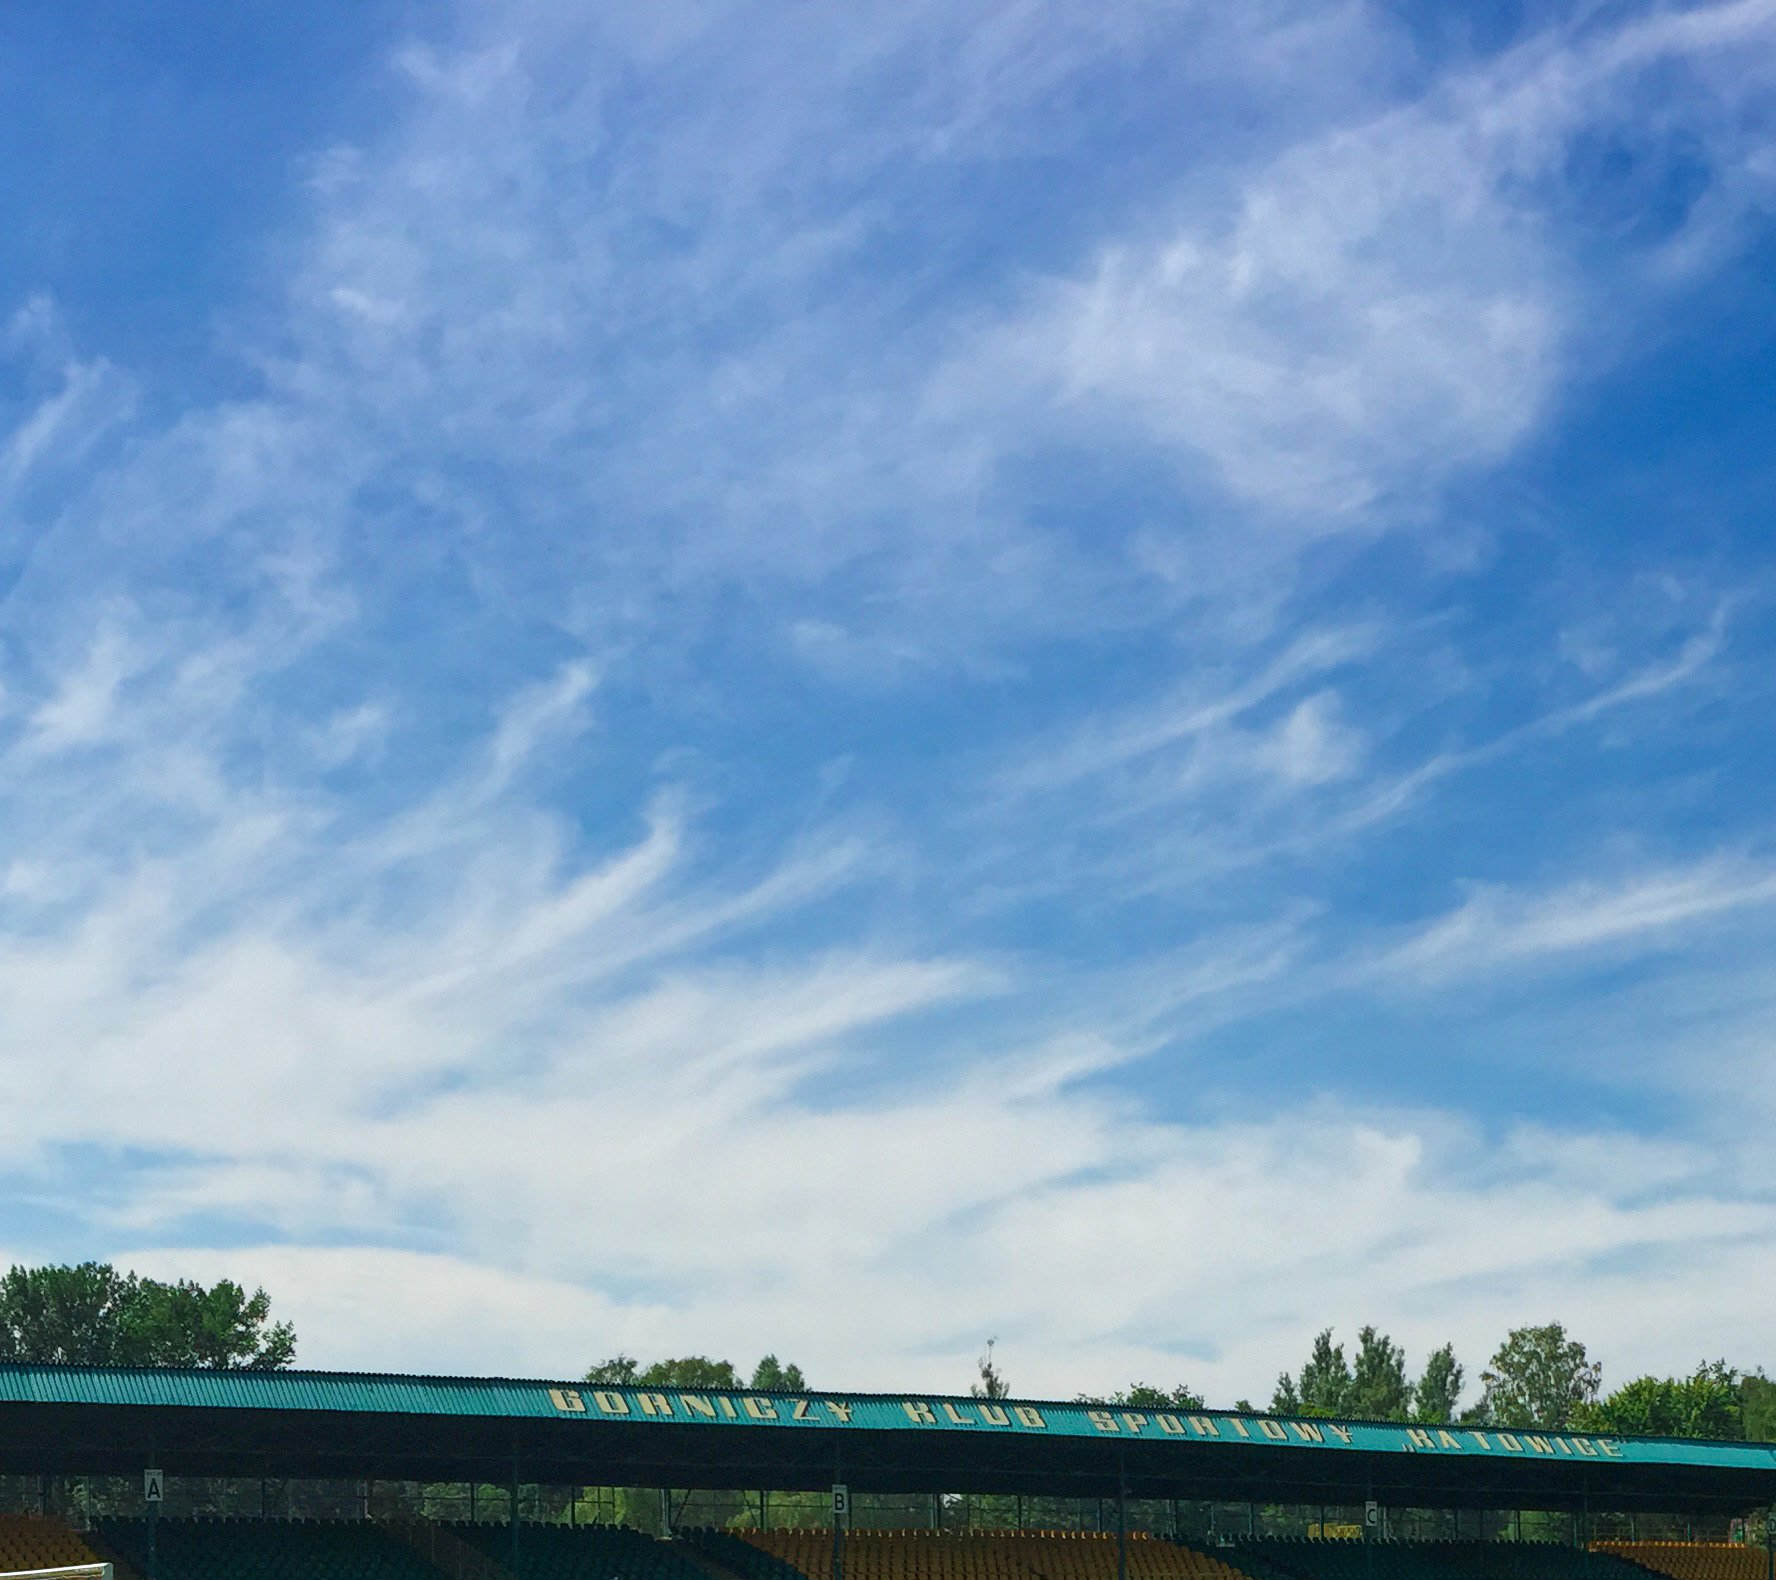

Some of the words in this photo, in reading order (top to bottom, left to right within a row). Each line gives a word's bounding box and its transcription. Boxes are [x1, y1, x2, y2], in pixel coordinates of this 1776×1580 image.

[901, 1401, 1047, 1429] KLUB
[1087, 1410, 1354, 1444] SPORTOWY
[147, 1477, 161, 1499] A
[834, 1492, 845, 1511] B
[1367, 1508, 1377, 1524] C
